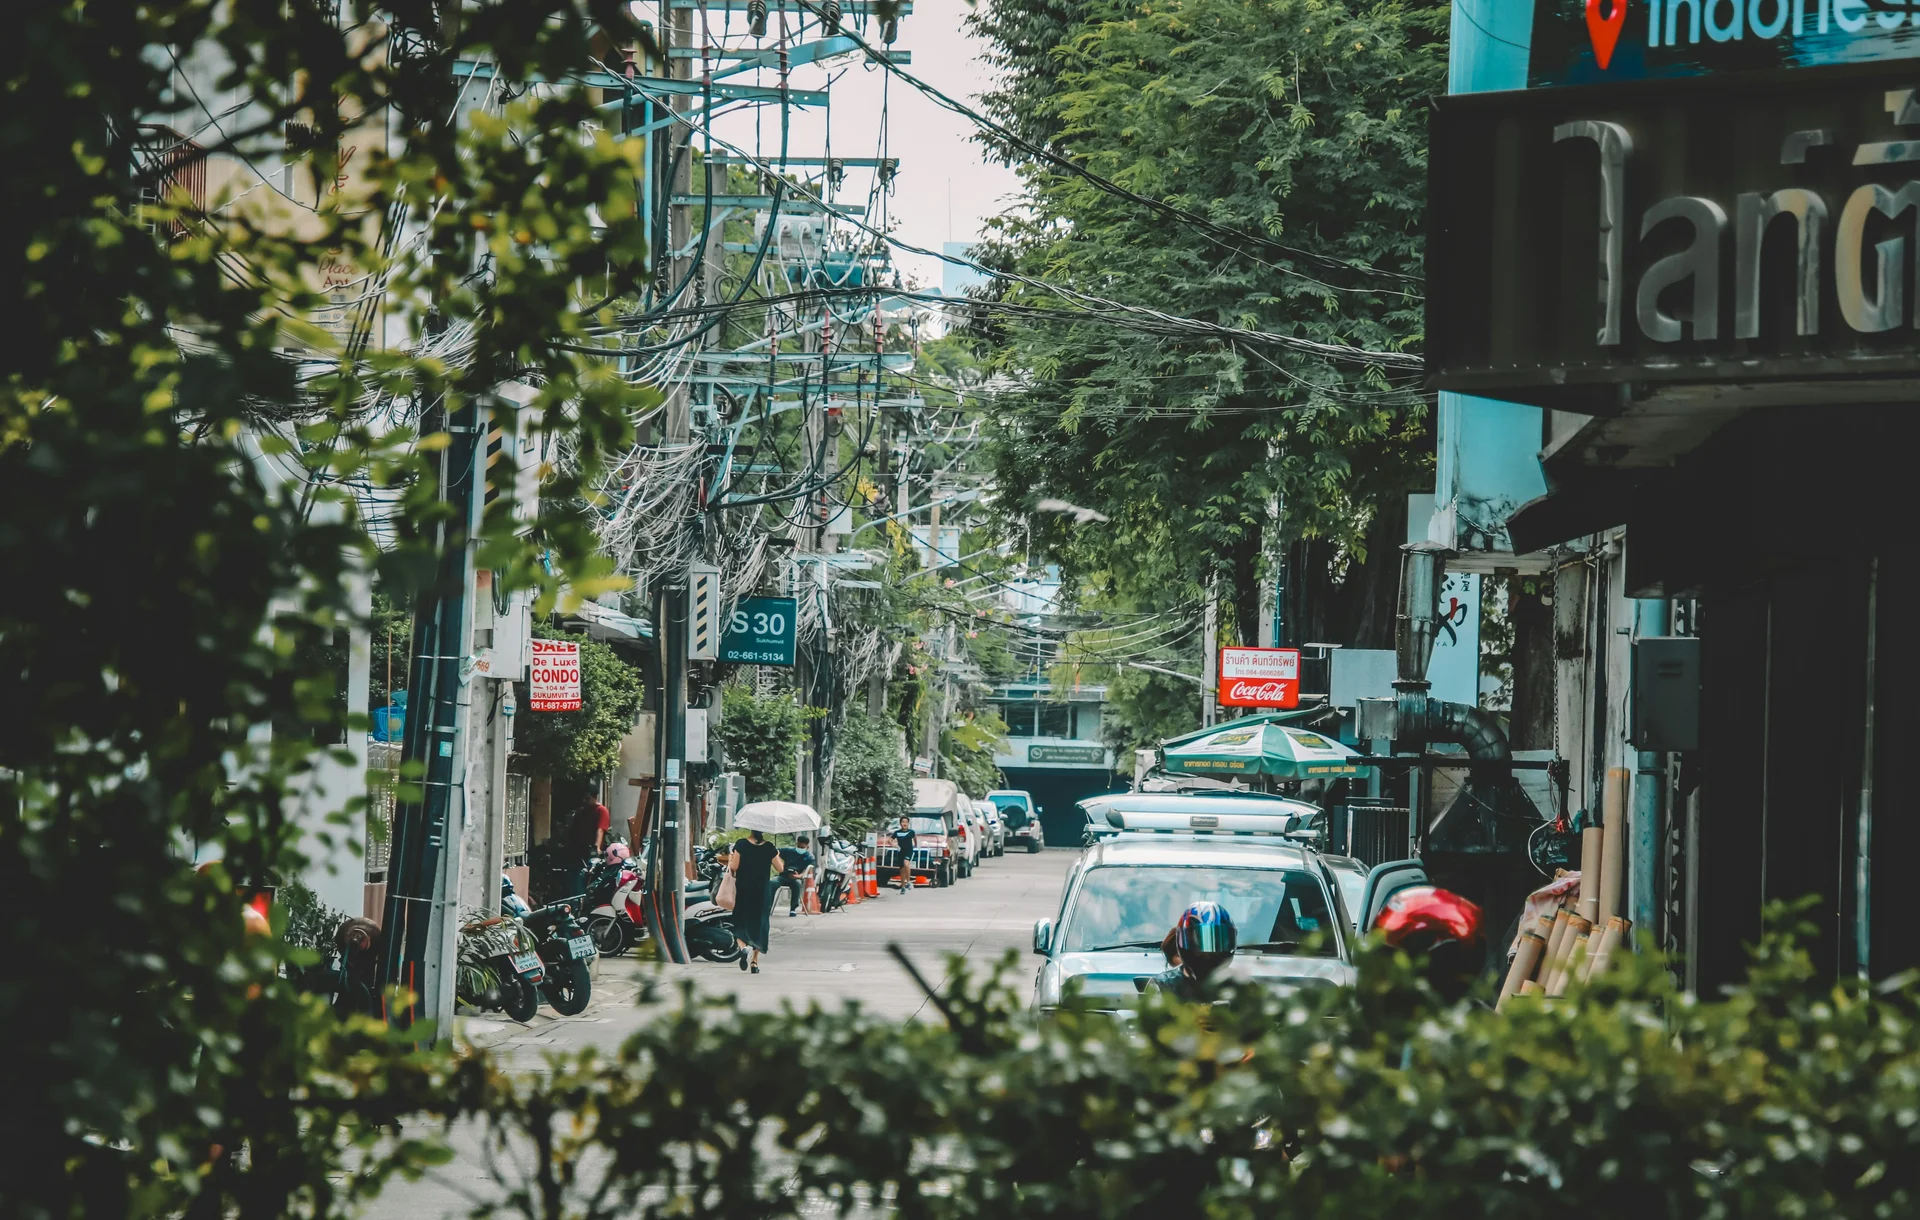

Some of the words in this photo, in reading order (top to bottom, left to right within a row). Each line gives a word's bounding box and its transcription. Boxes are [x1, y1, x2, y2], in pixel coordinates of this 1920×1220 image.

[533, 658, 547, 667] De
[553, 658, 578, 667] Luxe
[727, 650, 784, 662] 02-661-5134
[1225, 653, 1250, 666] ร้านค้า
[532, 669, 579, 683] CONDO
[1230, 681, 1288, 701] Coca-Cola
